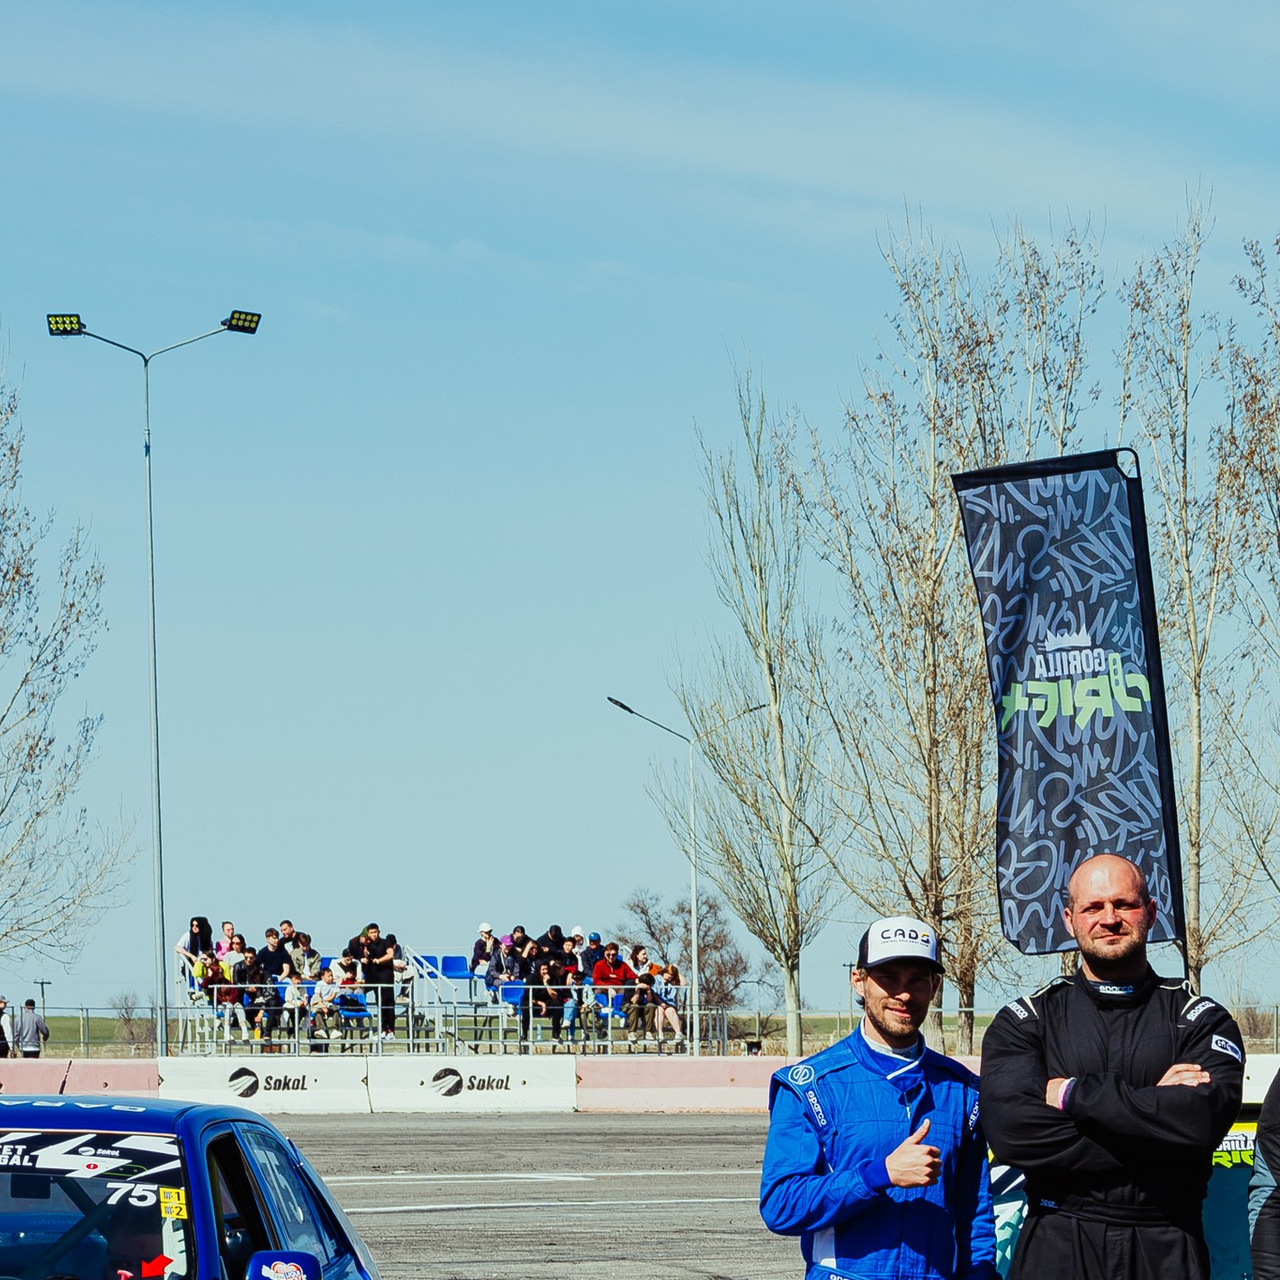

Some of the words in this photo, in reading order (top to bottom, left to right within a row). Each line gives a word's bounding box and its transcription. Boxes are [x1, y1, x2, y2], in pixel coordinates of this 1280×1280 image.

[264, 1075, 308, 1091] Sokol
[468, 1075, 511, 1091] Sokol
[0, 1145, 27, 1155] ET
[106, 1182, 158, 1207] 75
